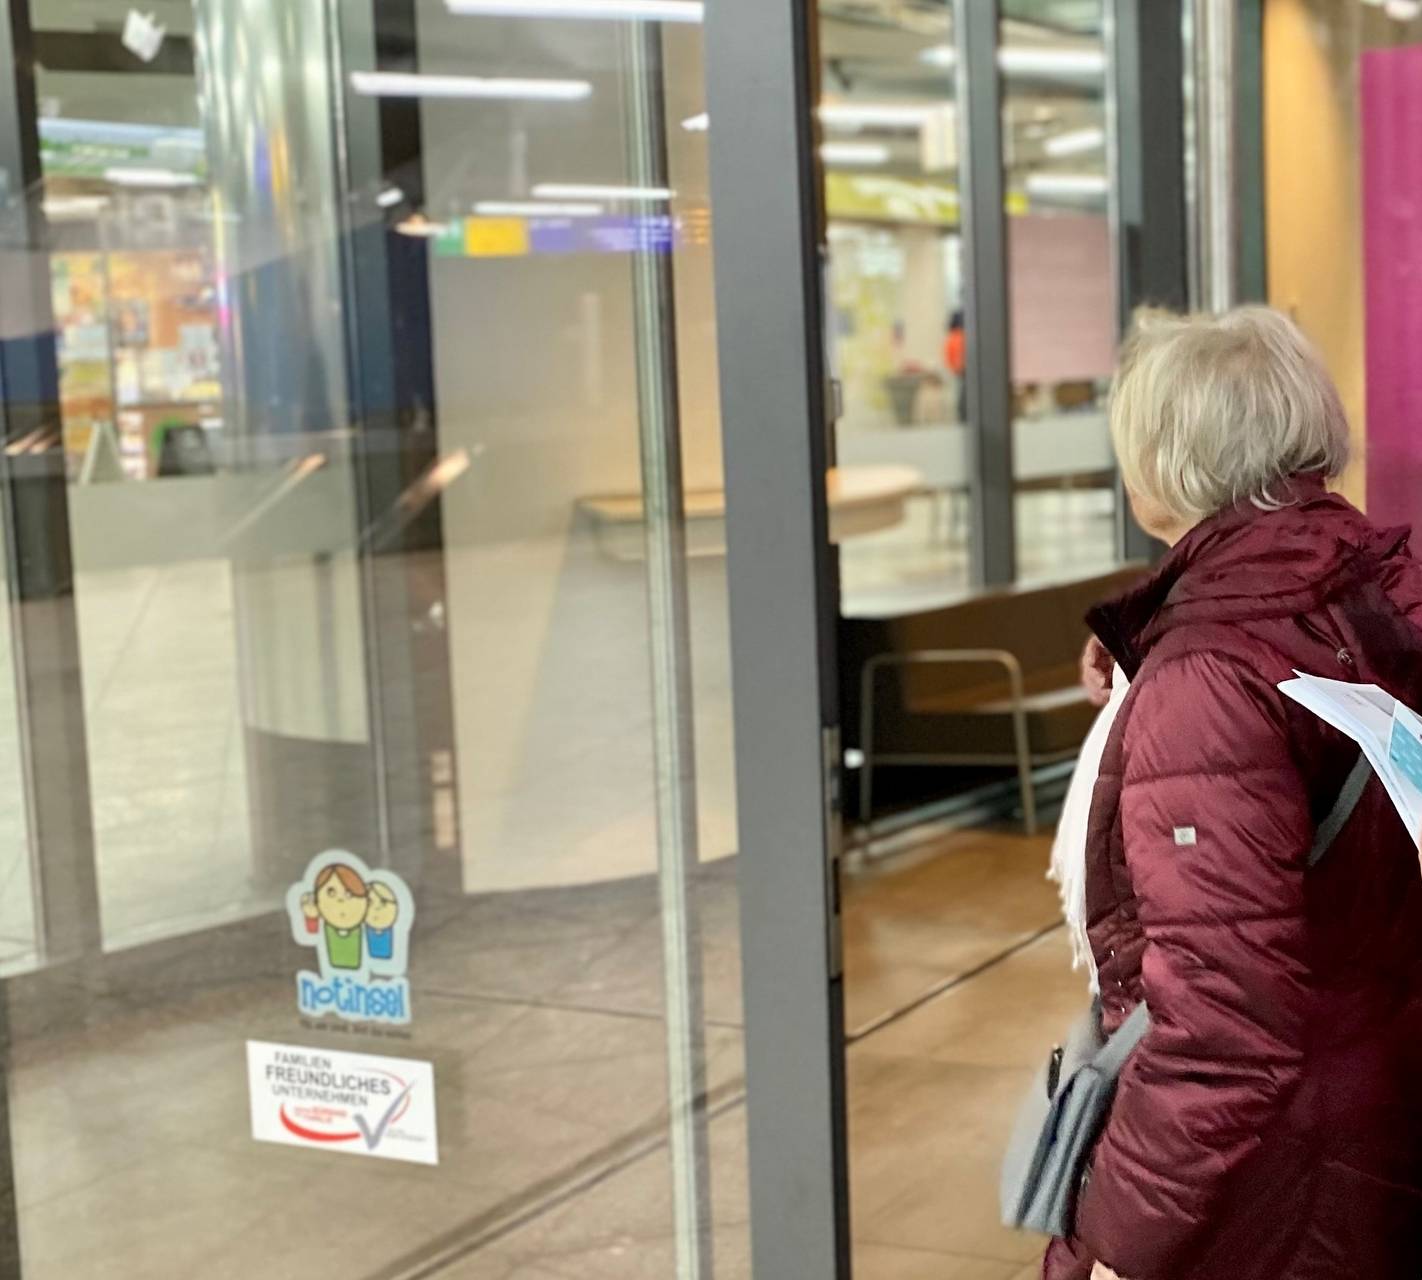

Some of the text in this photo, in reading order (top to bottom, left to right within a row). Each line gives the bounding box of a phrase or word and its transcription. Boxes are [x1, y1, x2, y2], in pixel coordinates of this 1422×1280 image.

[275, 1051, 332, 1069] FAMILIEN
[265, 1064, 391, 1095] FREUNDLICHES
[272, 1084, 368, 1106] UNTERNEHMEN
